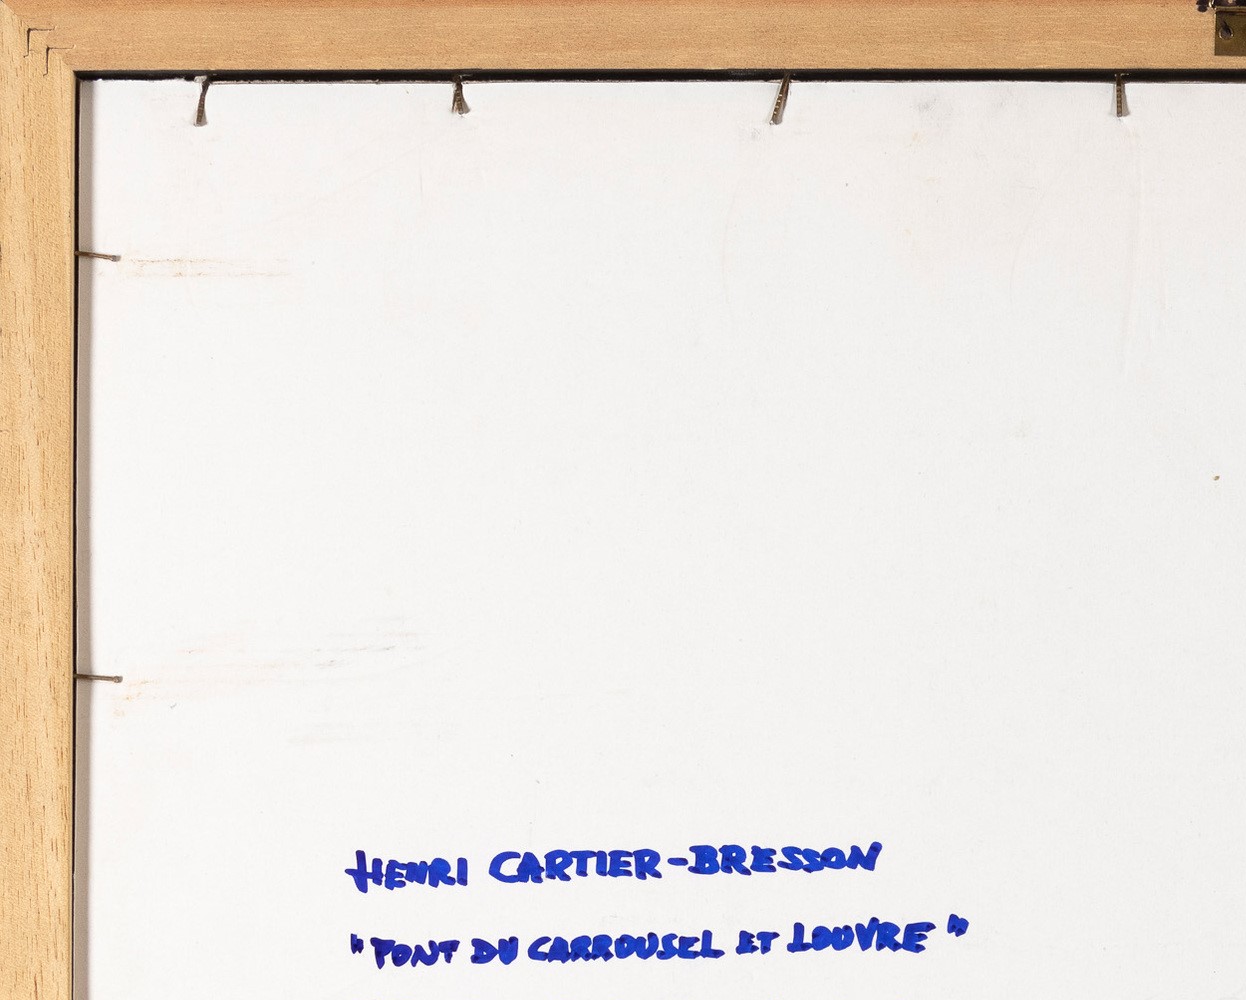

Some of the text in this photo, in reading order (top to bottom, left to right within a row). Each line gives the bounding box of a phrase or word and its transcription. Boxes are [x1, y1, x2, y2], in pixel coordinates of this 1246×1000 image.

[346, 842, 882, 893] HENRI CARTIER-BRESSON
[470, 936, 519, 966] DU
[527, 930, 725, 964] CARROUSEL
[736, 930, 780, 955] ET
